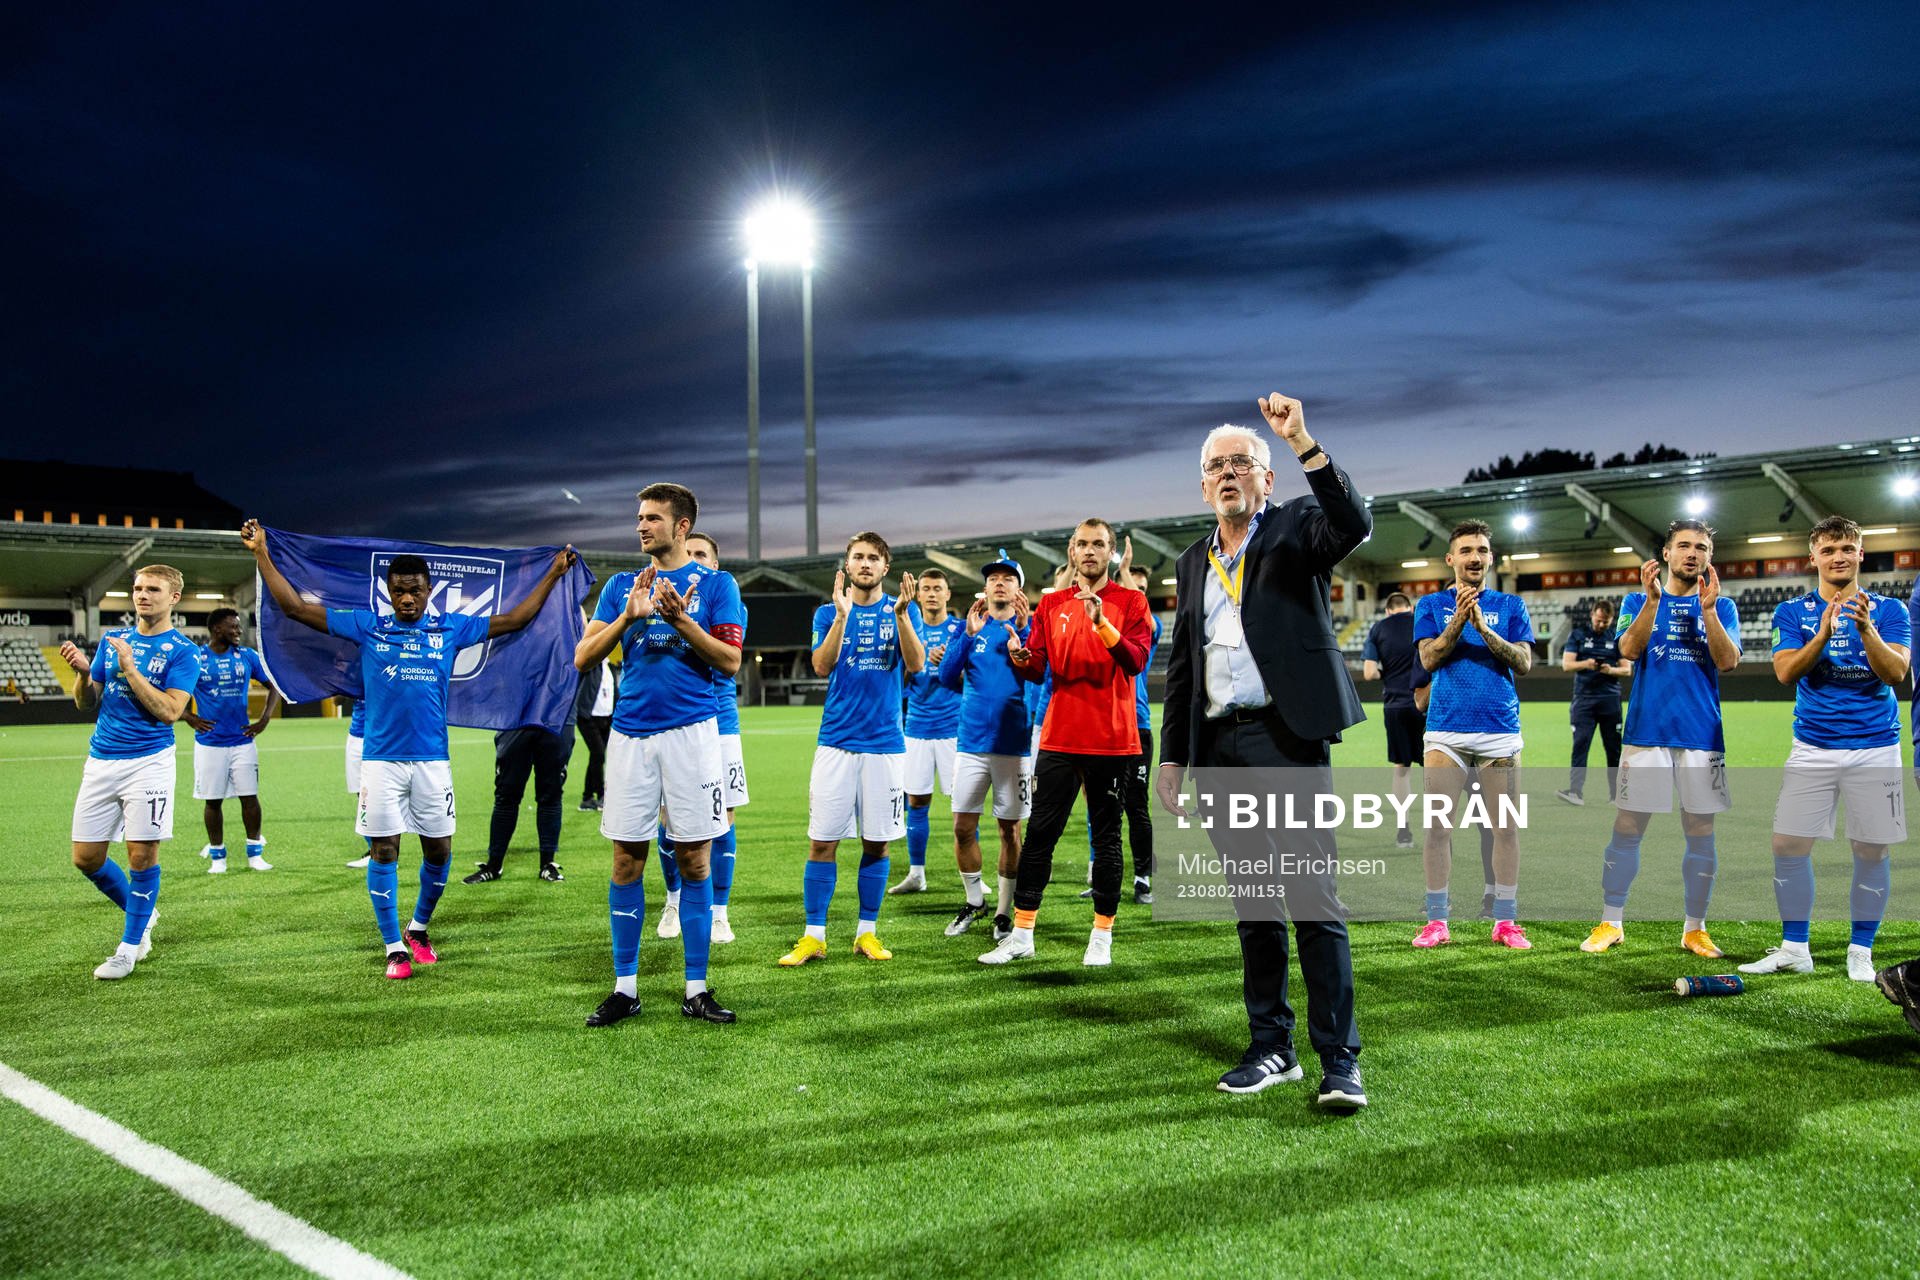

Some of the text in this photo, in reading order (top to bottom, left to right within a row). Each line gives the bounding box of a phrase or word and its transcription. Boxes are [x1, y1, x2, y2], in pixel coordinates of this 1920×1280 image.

[1062, 623, 1067, 633] 1
[1830, 639, 1849, 647] KBI
[729, 766, 745, 789] 23
[148, 797, 167, 821] 17
[713, 787, 722, 816] 8
